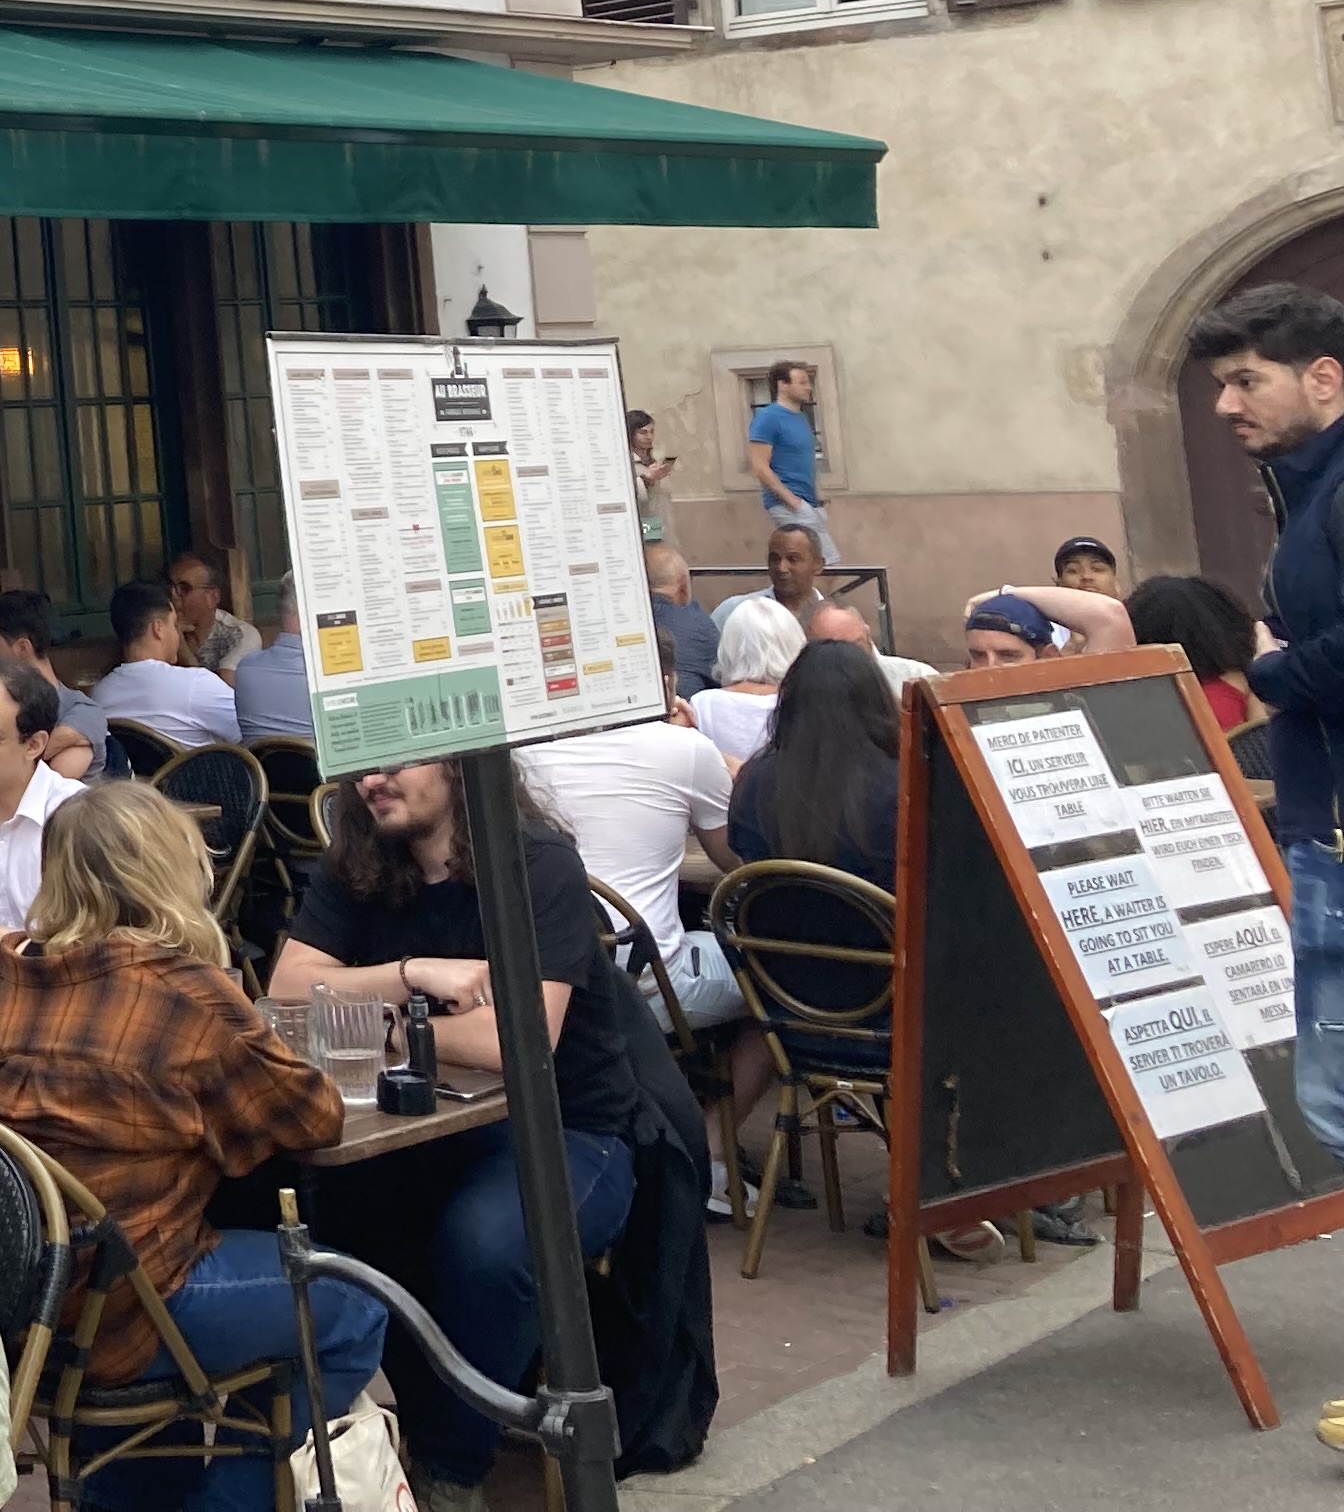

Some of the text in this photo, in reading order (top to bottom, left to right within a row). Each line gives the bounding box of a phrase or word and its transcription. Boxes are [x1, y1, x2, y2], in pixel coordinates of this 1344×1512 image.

[987, 724, 1084, 749] MERCI DE PATIENTER
[1028, 759, 1045, 772] UN
[1045, 752, 1088, 769] SERVEUR
[1008, 773, 1109, 801] VOUS TROUVERA UNE
[1054, 801, 1085, 817] TABLE
[1067, 870, 1135, 895] PLEASE WAIT
[1061, 896, 1167, 929] HERE, A WAITER IS
[1079, 921, 1174, 953] GOING TO SIT YOU
[1203, 937, 1236, 956] ESPERE
[1108, 948, 1169, 973] AT A TABLE.
[1225, 954, 1285, 978] CAMARERO LO
[1268, 979, 1282, 993] EN
[1281, 977, 1295, 990] UN
[1124, 1019, 1170, 1042] ASPETTA
[1129, 1048, 1171, 1071] SERVER
[1170, 1045, 1182, 1060] TI
[1159, 1062, 1223, 1090] UN TAVOLO.
